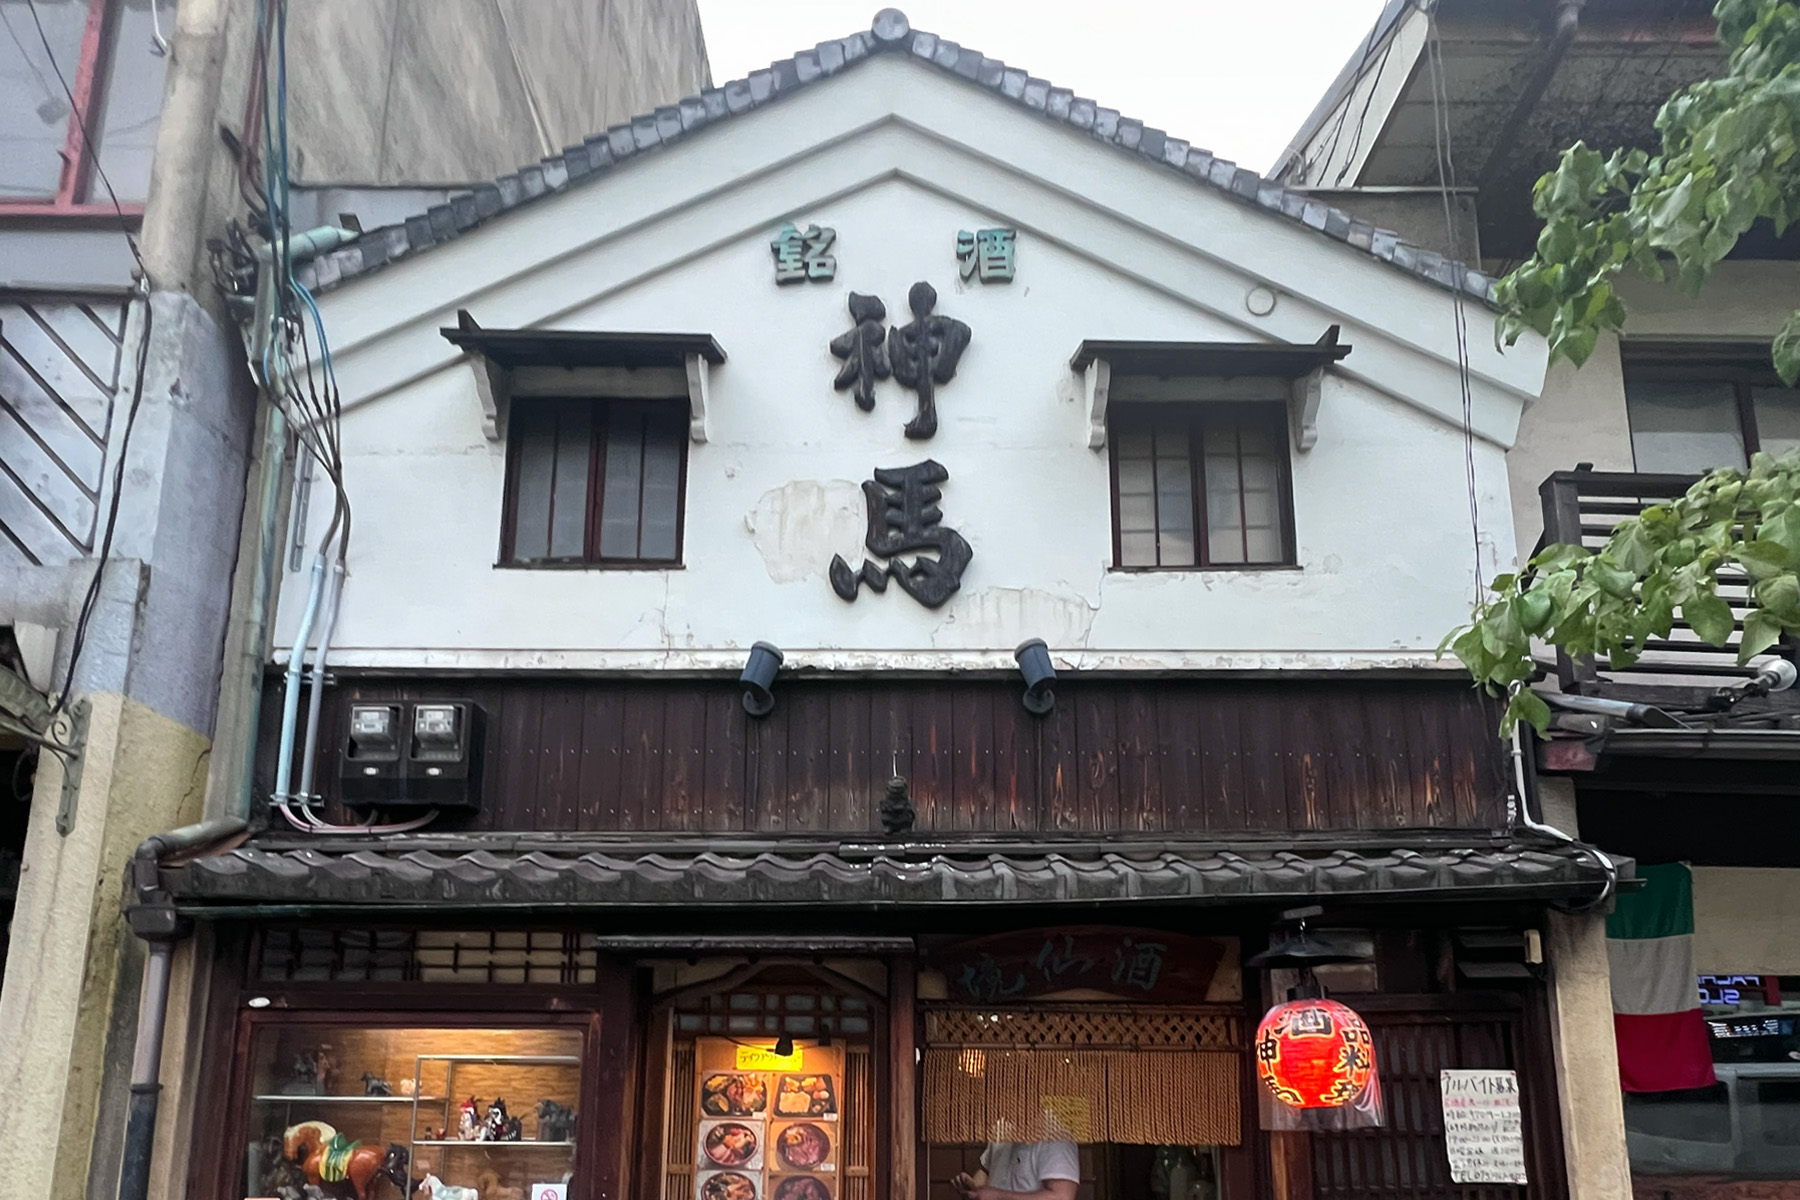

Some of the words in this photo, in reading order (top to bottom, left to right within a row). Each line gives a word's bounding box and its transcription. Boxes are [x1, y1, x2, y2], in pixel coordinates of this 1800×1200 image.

[829, 281, 974, 609] 神馬
[1442, 1076, 1517, 1094] アルバイト募集
